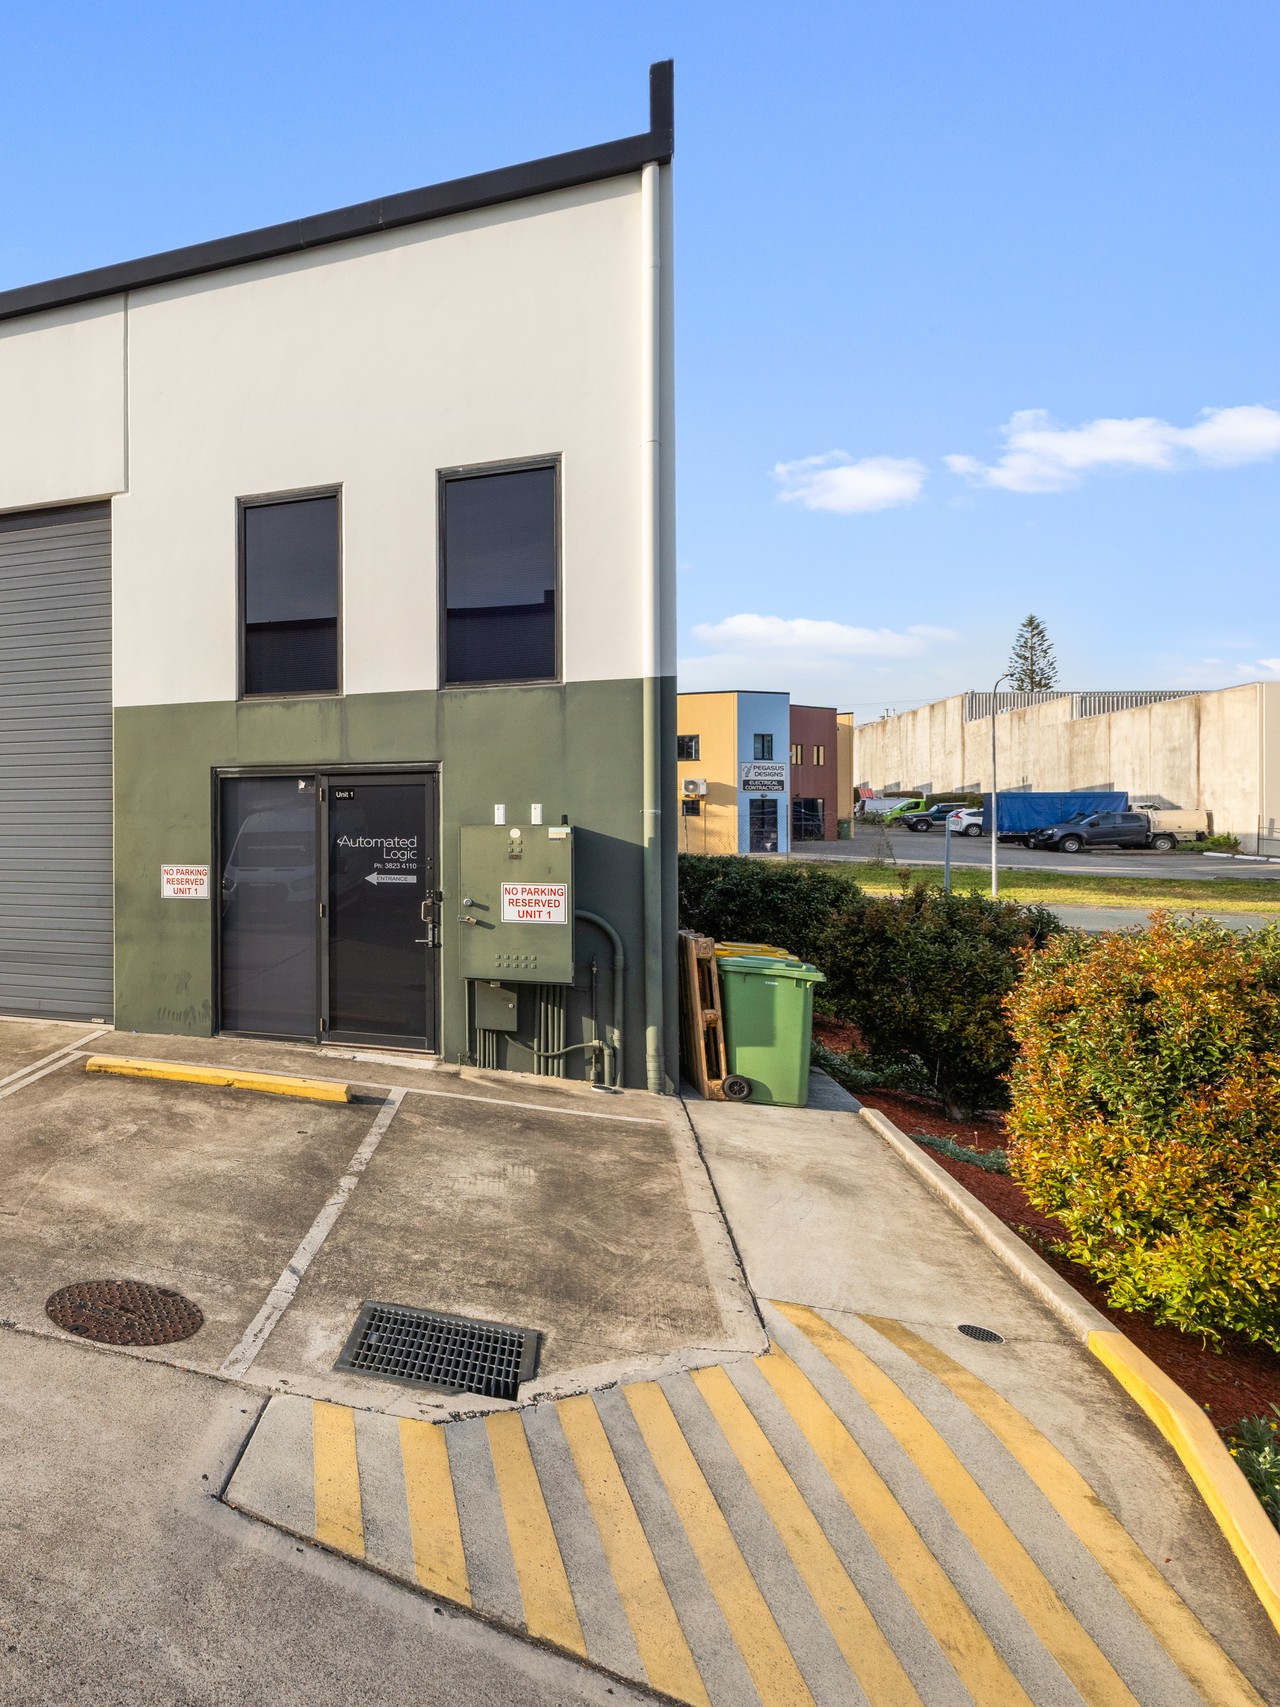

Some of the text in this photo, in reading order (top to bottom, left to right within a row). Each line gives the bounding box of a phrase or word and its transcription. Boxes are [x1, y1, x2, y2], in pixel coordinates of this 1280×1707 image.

[337, 835, 417, 848] Automated
[383, 847, 418, 861] Logic
[505, 887, 564, 896] NO PARKING
[508, 898, 561, 908] RESERVED
[517, 910, 551, 919] UNIT 1
